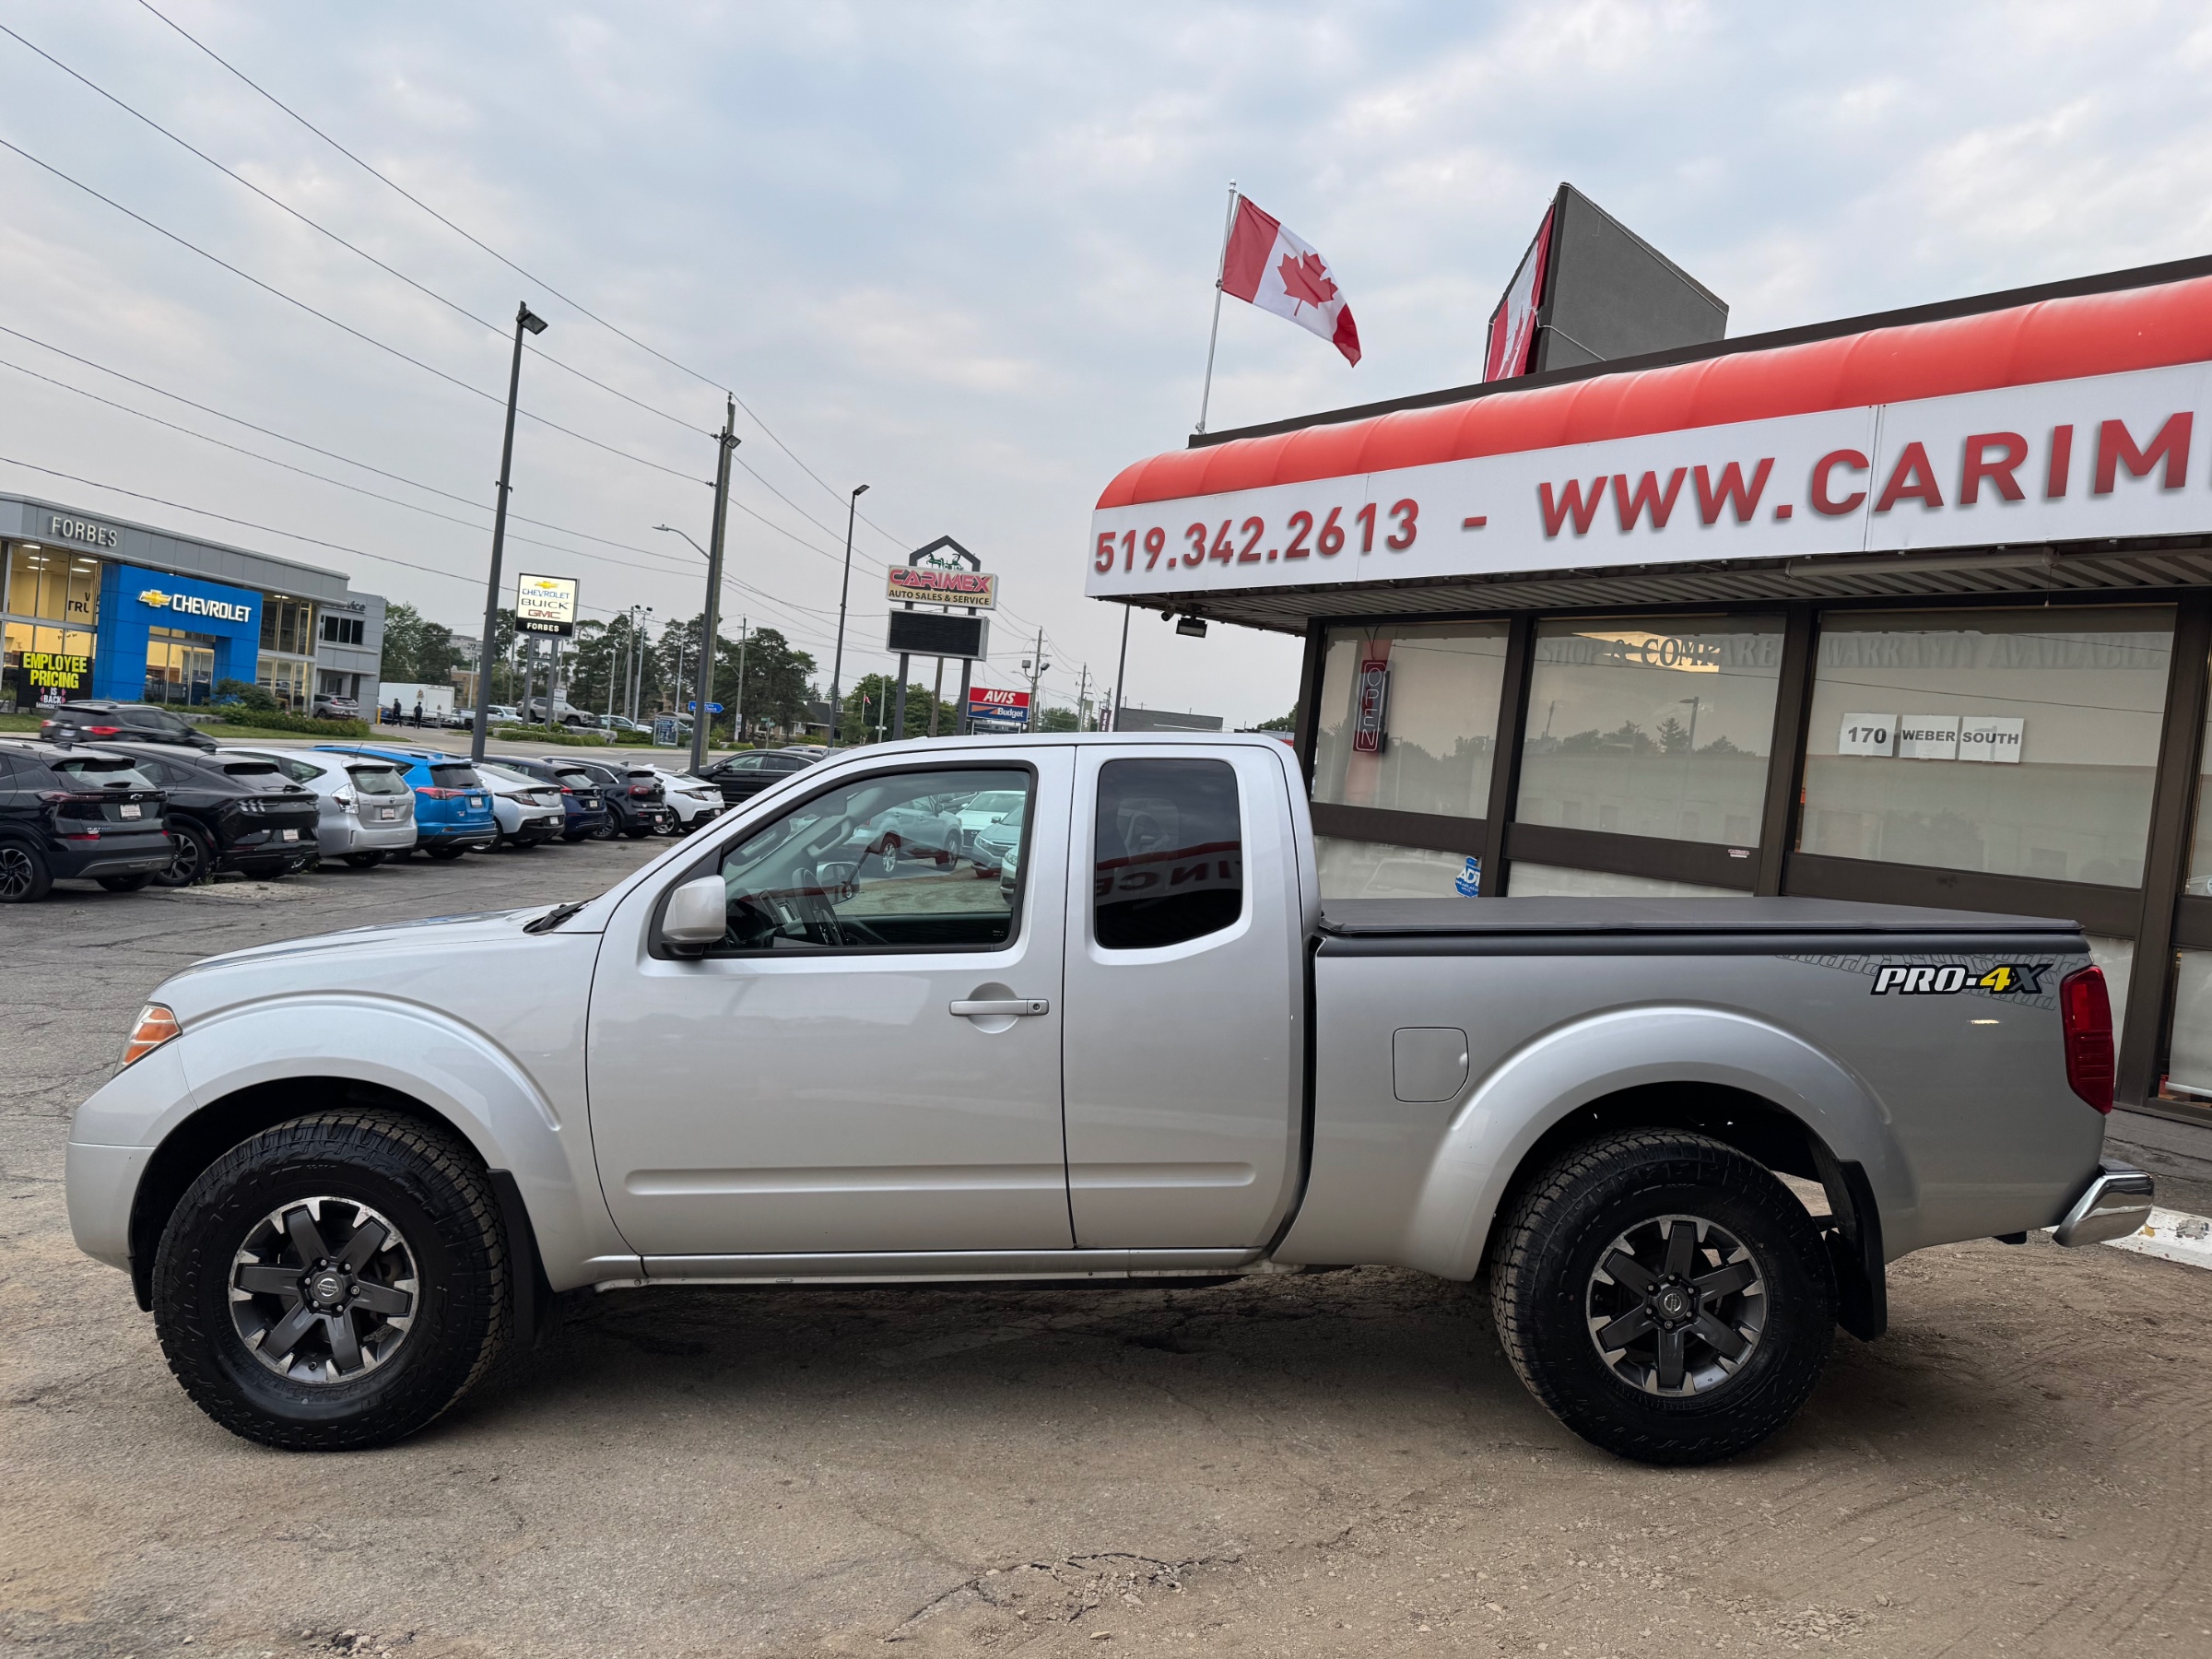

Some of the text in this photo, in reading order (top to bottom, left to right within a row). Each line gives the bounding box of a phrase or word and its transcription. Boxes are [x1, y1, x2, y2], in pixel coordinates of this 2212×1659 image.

[51, 516, 118, 547] FORBES
[1095, 498, 1419, 572] 519.342.2613
[889, 569, 992, 593] CARIMEX
[522, 588, 571, 599] CHEVROLET
[888, 589, 913, 599] AUTO
[915, 592, 942, 602] SALES
[953, 594, 990, 606] SERVICE
[172, 594, 252, 623] CHEVROLET
[521, 598, 571, 610] BUICK
[528, 609, 561, 619] GMC
[526, 622, 559, 632] FORBES
[23, 653, 88, 673] EMPLOYEE
[29, 669, 79, 689] PRICING
[43, 694, 62, 704] BACK
[50, 687, 57, 696] IS
[982, 690, 1016, 704] AVIS
[997, 708, 1024, 719] Budget
[1360, 667, 1382, 746] OPEN
[1083, 710, 1091, 728] Jeep
[1848, 727, 2018, 744] 170 WEBER SOUTH
[1872, 964, 2053, 994] PRO-4X
